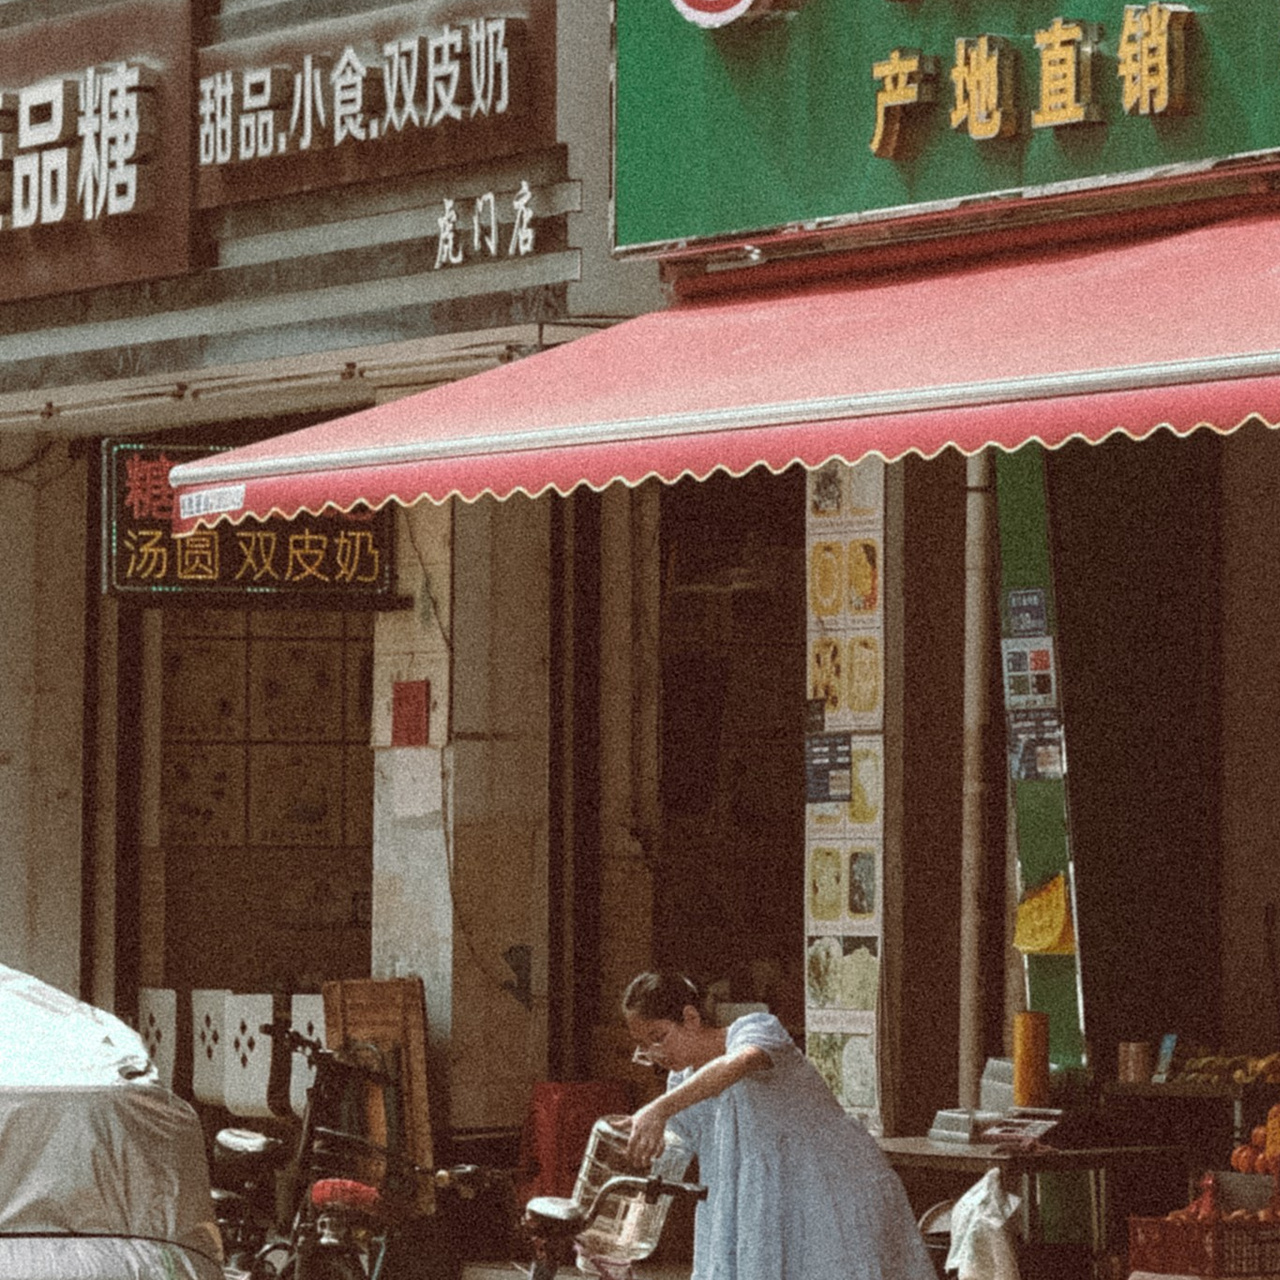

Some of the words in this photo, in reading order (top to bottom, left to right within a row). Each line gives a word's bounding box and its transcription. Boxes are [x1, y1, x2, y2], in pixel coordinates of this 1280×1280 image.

[870, 3, 1172, 156] 产地直销
[0, 60, 139, 227] 品糖
[434, 180, 536, 270] 虎门店
[123, 529, 219, 581] 汤圆
[232, 528, 380, 584] 双皮奶
